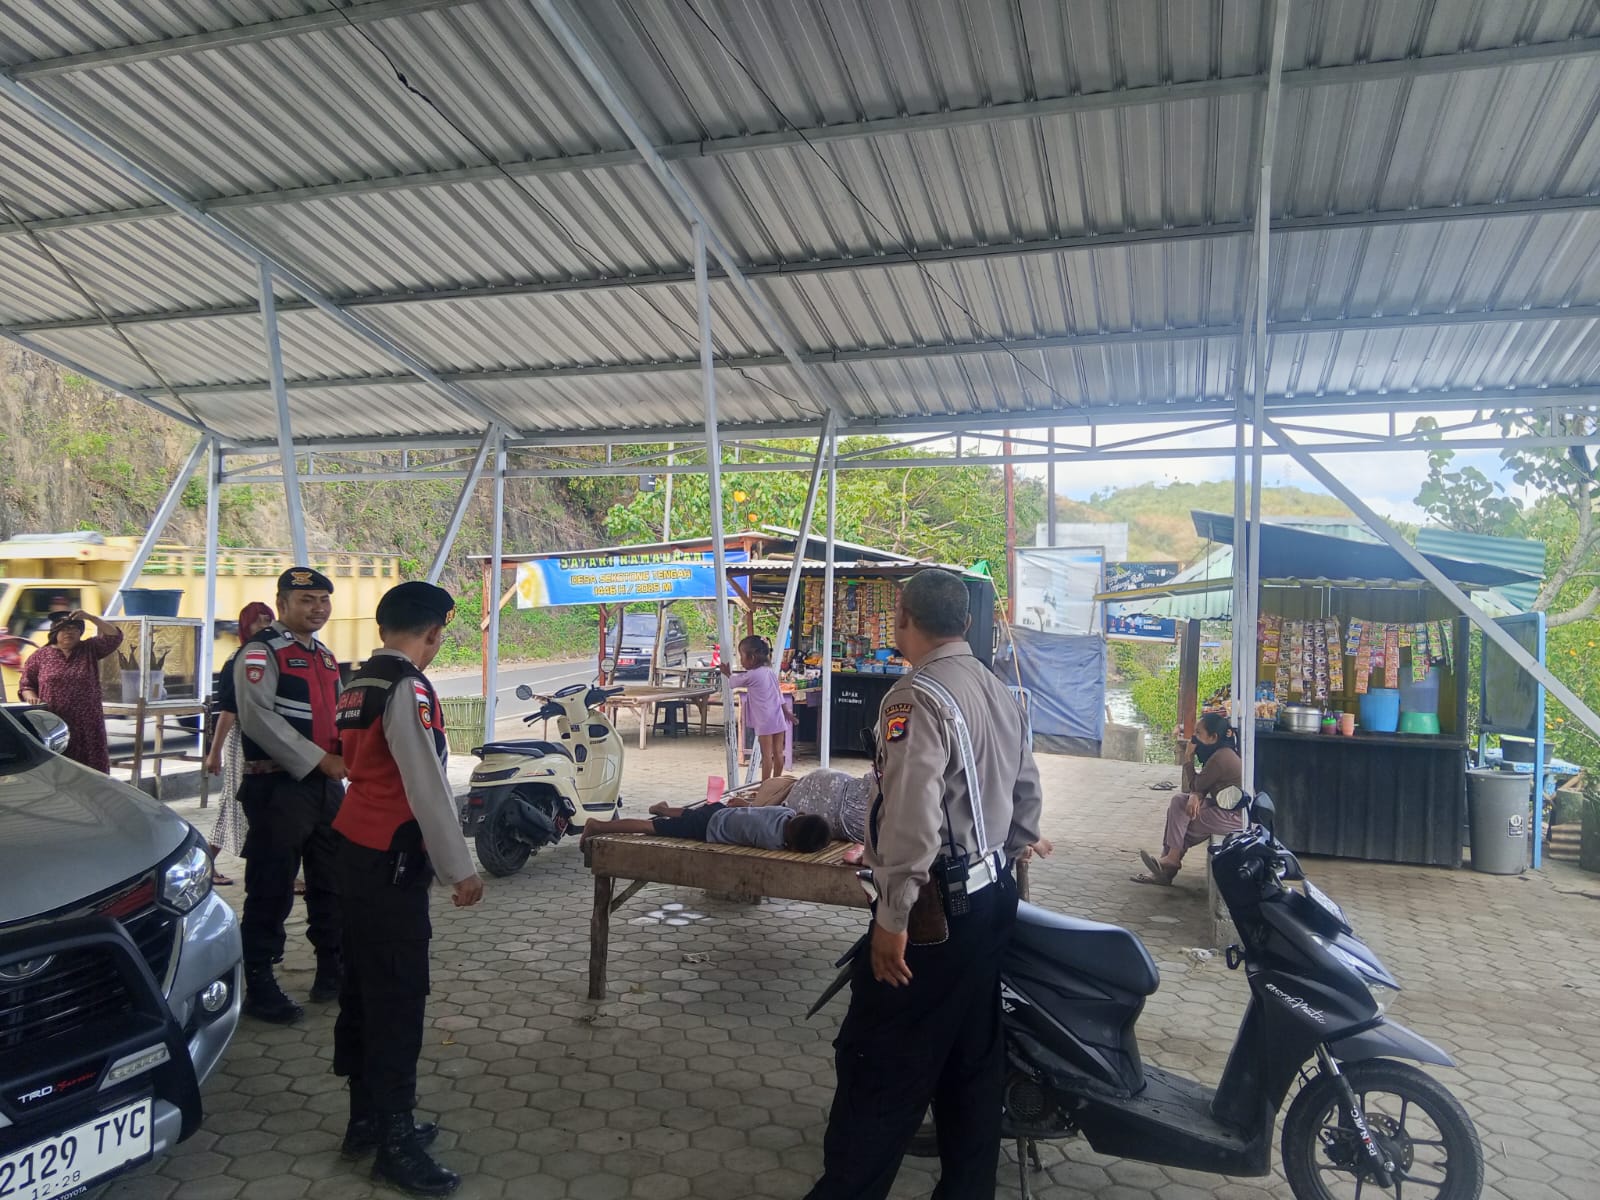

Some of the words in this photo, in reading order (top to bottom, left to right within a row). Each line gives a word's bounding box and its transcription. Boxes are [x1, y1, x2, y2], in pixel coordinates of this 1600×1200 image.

[571, 575, 596, 584] DESA
[600, 571, 649, 583] SEKOTONG
[653, 569, 691, 580] TENGAH
[594, 585, 616, 595] 1446
[17, 1085, 53, 1104] TRD
[0, 1135, 78, 1198] 2129
[94, 1105, 146, 1155] TYC
